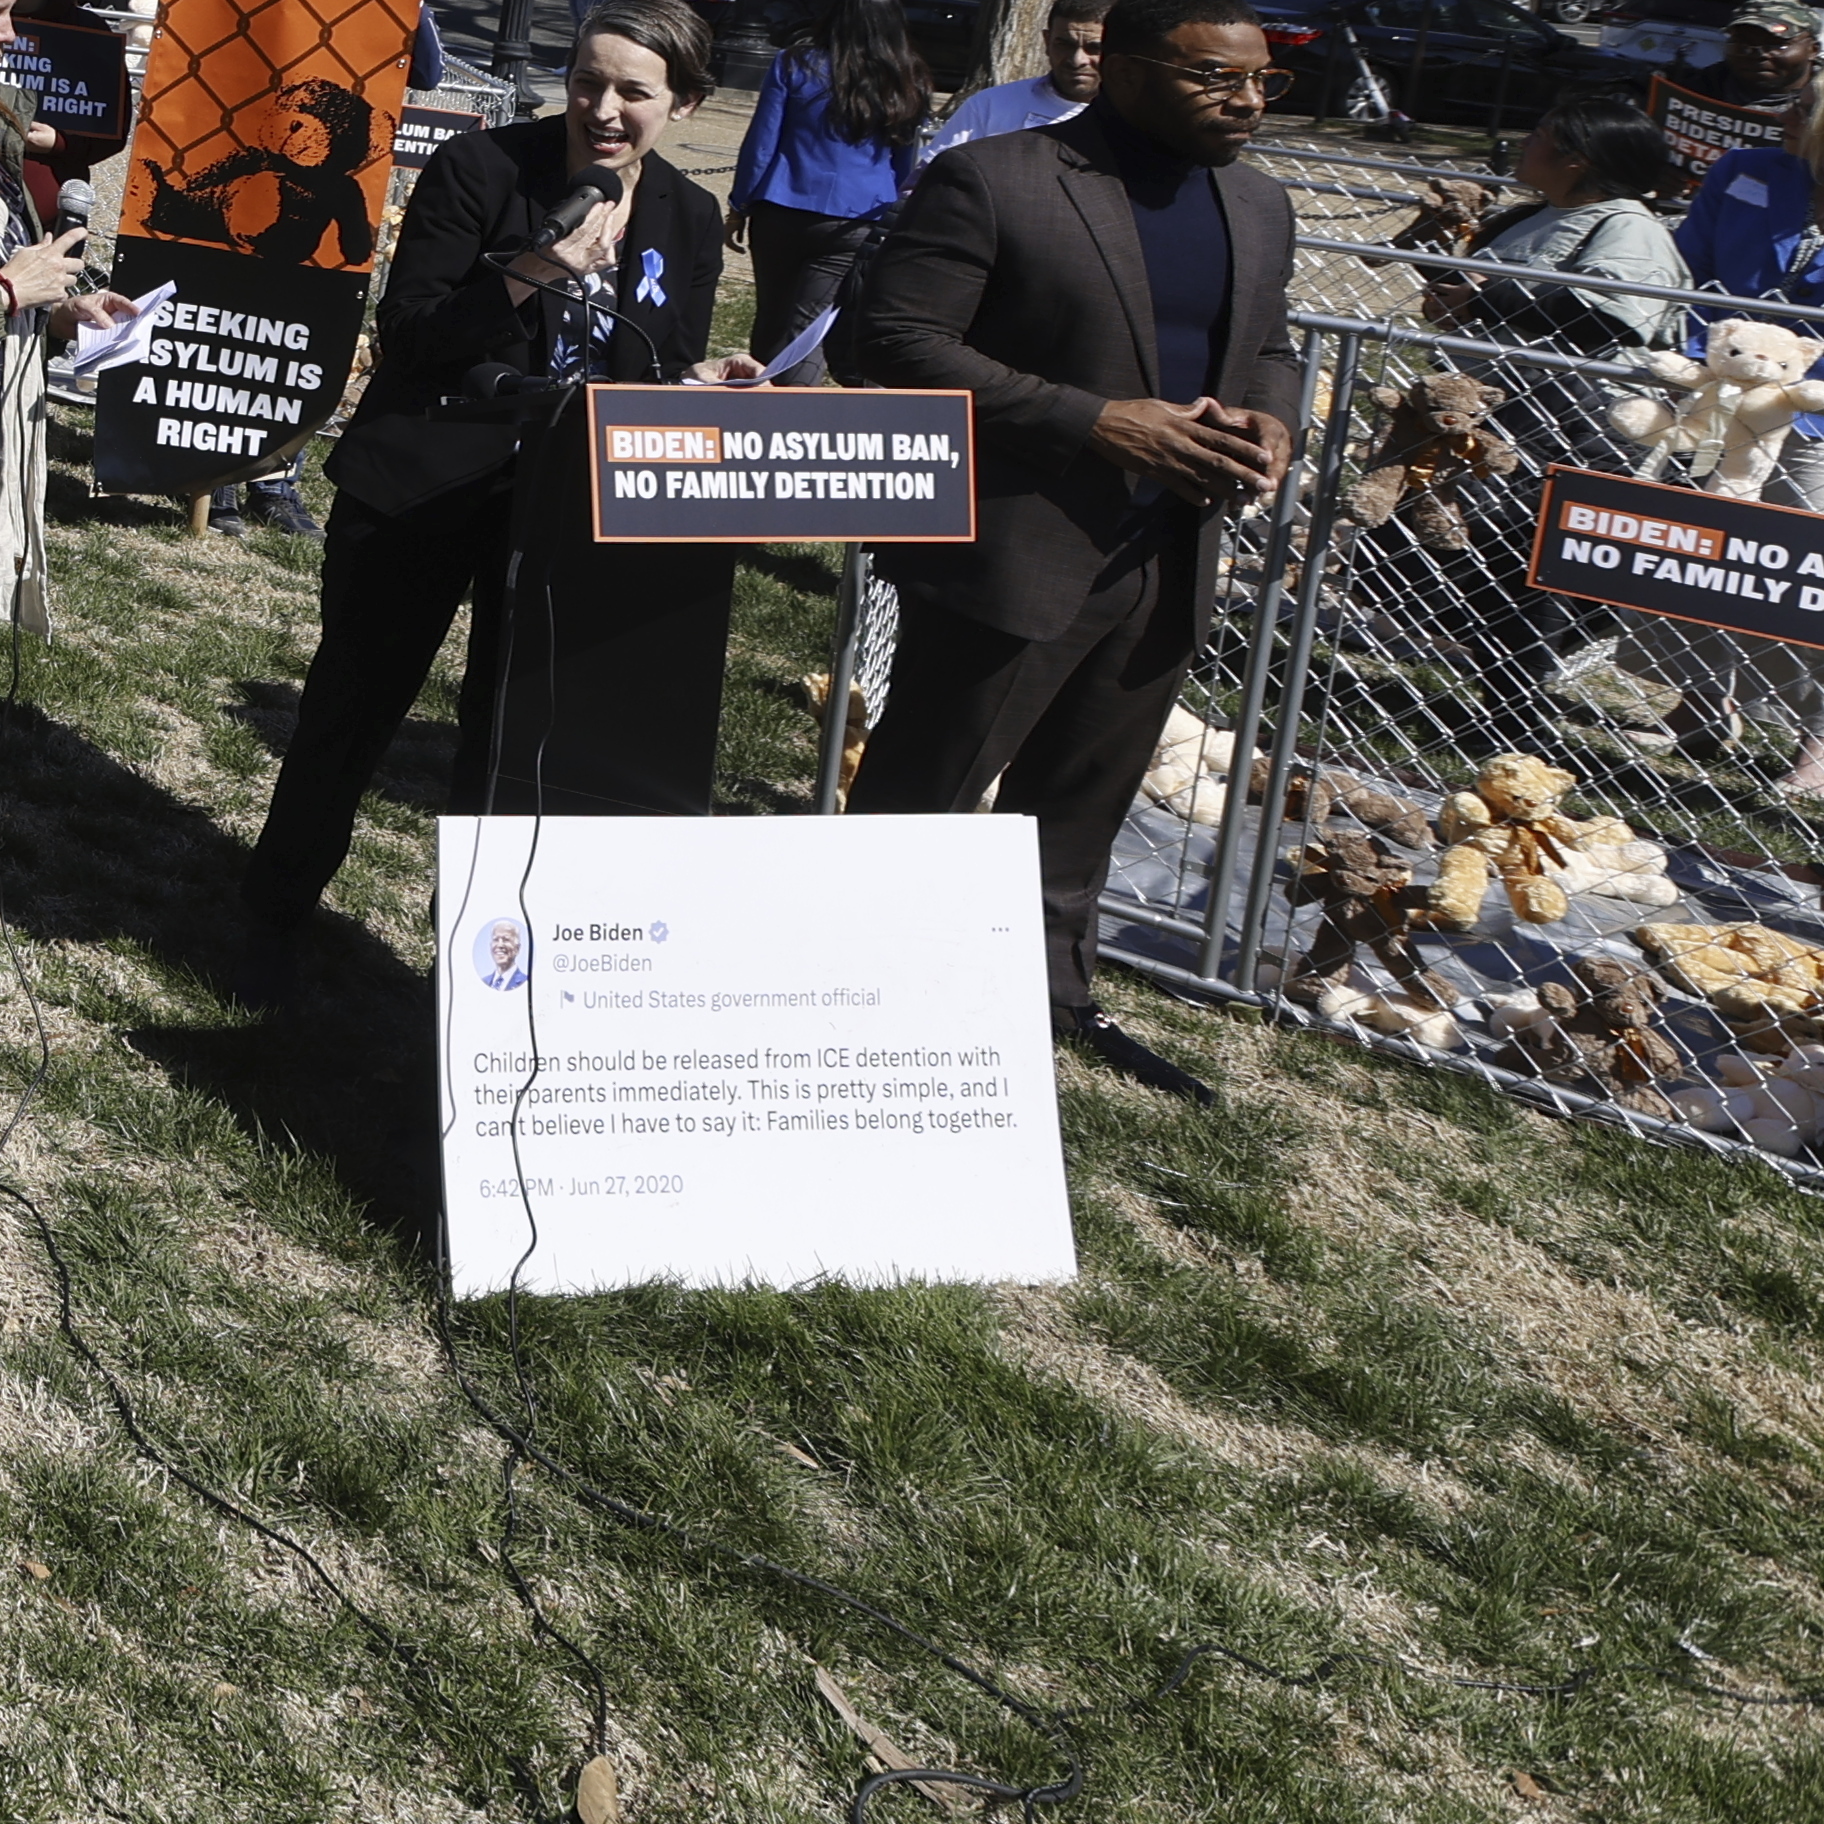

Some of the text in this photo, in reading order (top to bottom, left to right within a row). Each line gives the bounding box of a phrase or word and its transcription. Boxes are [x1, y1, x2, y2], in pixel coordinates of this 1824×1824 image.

[50, 77, 88, 97] IS A
[42, 95, 107, 117] RIGHT
[152, 300, 310, 351] SEEKING
[284, 361, 323, 390] IS
[132, 376, 302, 424] A HUMAN
[156, 417, 268, 457] RIGHT
[611, 430, 959, 469] BIDEN: NO ASYLUM BAN,
[614, 472, 935, 499] NO FAMILY DETENTION
[1567, 506, 1789, 570] BIDEN: NO
[1561, 537, 1792, 604] NO FAMILY
[552, 923, 643, 942] Joe Biden
[552, 954, 652, 973] @JoeBiden
[583, 987, 881, 1012] United States government official
[473, 1045, 1001, 1074] Children should be released from ICE detention with
[474, 1074, 1009, 1108] their parents immediately. This is pretty simple, and I
[532, 1107, 1018, 1137] believe I have to say it: Families belong together.
[479, 1175, 684, 1198] 6:42 PM Jun 27, 2020
